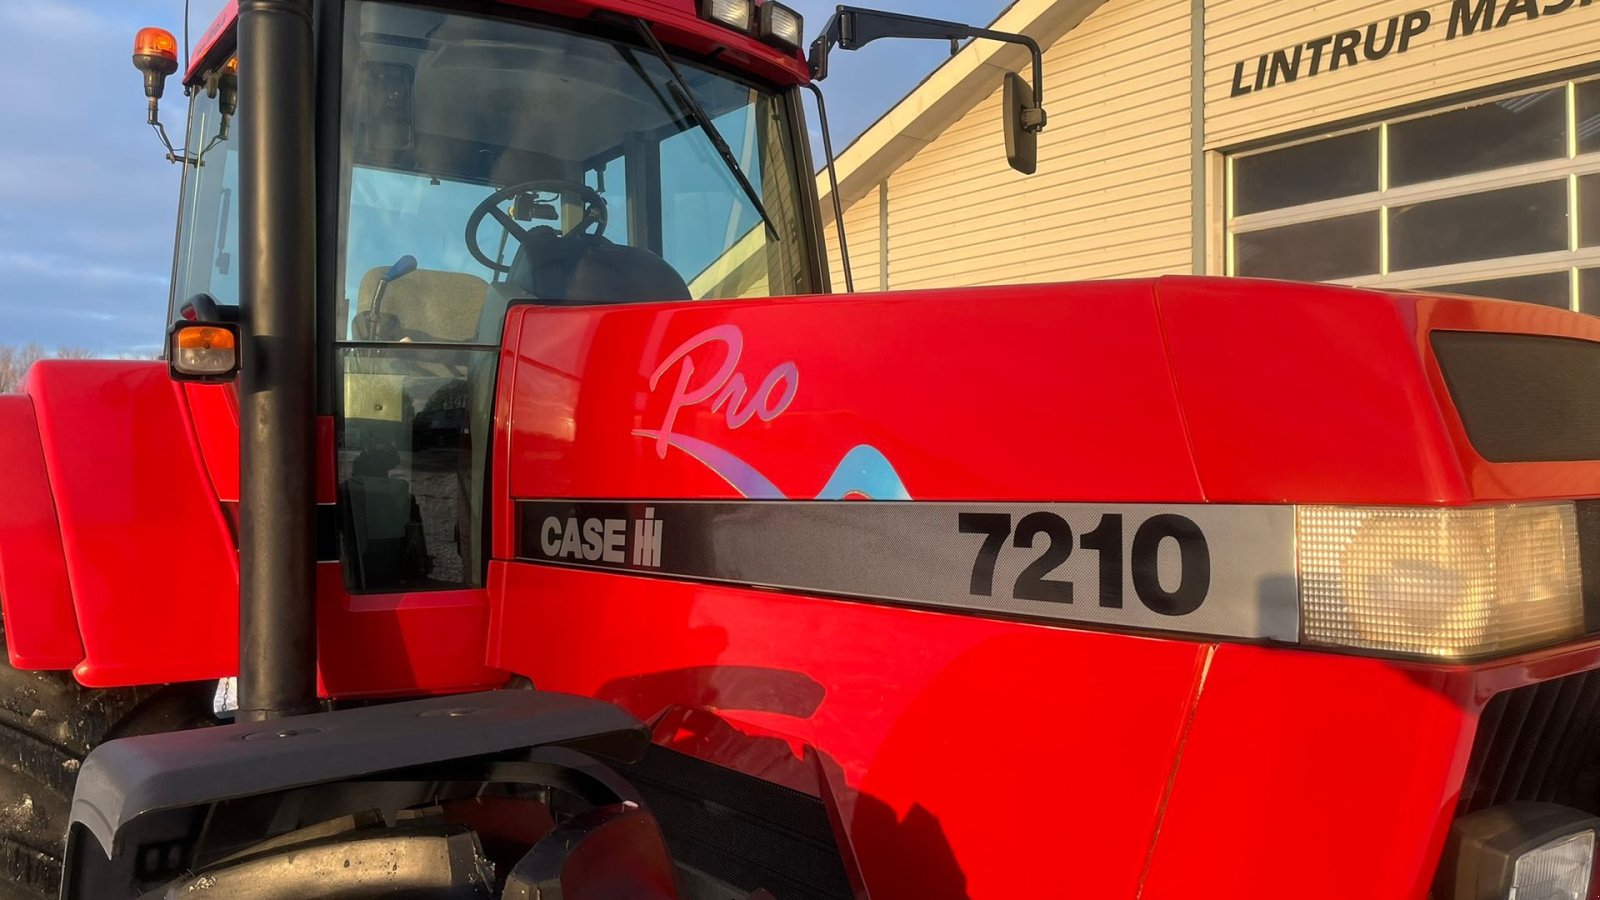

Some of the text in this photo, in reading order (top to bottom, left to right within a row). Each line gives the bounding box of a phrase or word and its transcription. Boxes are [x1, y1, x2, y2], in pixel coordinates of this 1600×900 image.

[1230, 10, 1431, 98] LINTRUP
[649, 324, 799, 460] Pro
[540, 516, 627, 563] CASE
[958, 511, 1211, 616] 7210
